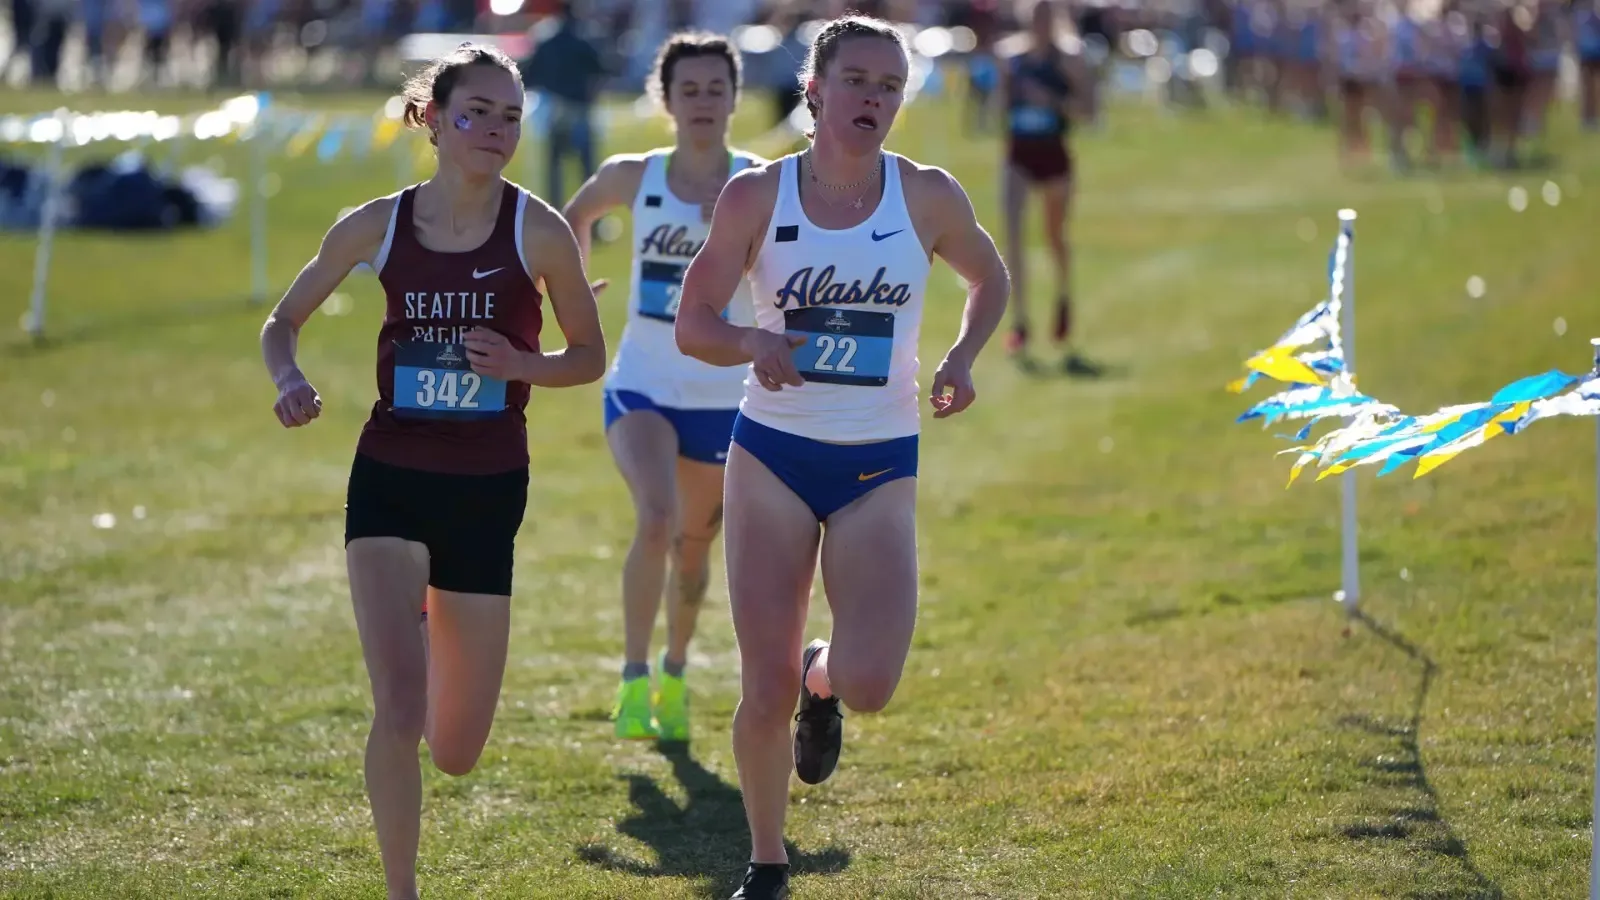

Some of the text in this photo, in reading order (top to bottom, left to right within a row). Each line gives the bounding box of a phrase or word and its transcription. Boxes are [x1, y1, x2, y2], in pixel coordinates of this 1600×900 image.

[405, 292, 495, 319] SEATTLE
[773, 264, 911, 309] Alaska
[814, 335, 858, 373] 22
[416, 369, 481, 408] 342
